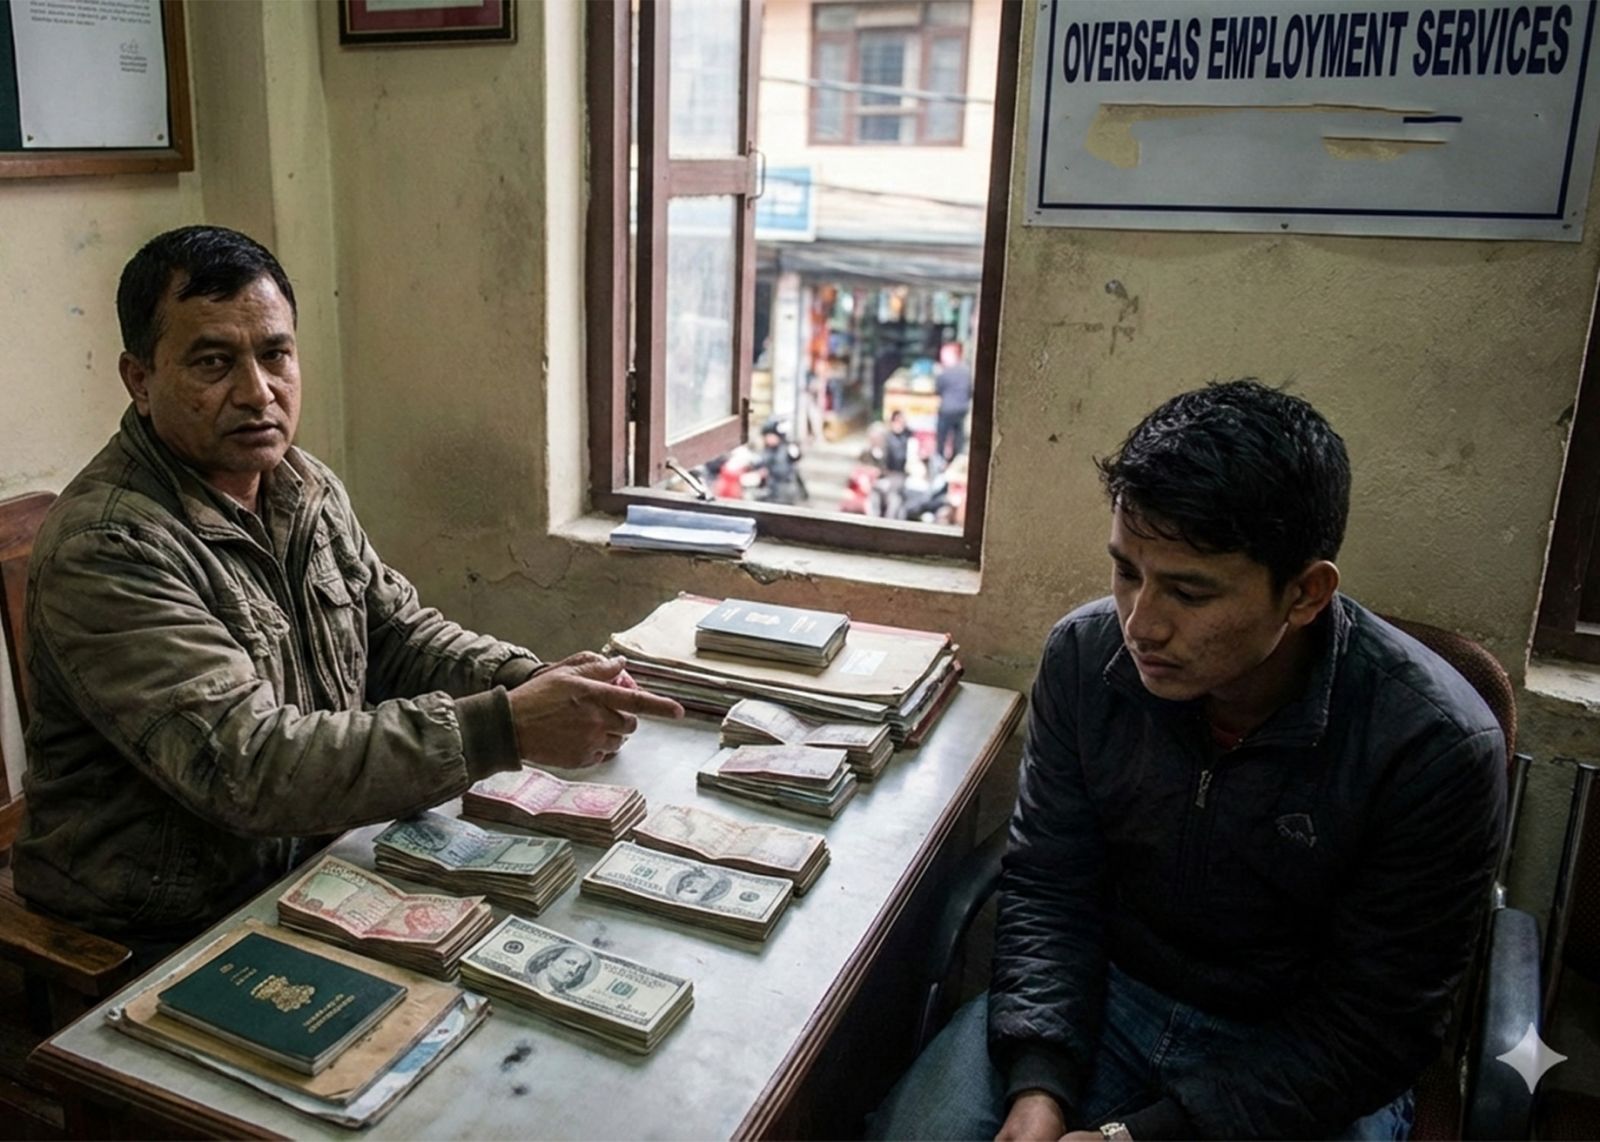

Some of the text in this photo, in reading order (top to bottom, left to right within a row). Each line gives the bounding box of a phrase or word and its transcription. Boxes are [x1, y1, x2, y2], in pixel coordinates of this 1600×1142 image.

[1063, 4, 1573, 83] OVERSEAS EMPLOYMENT SERVICES
